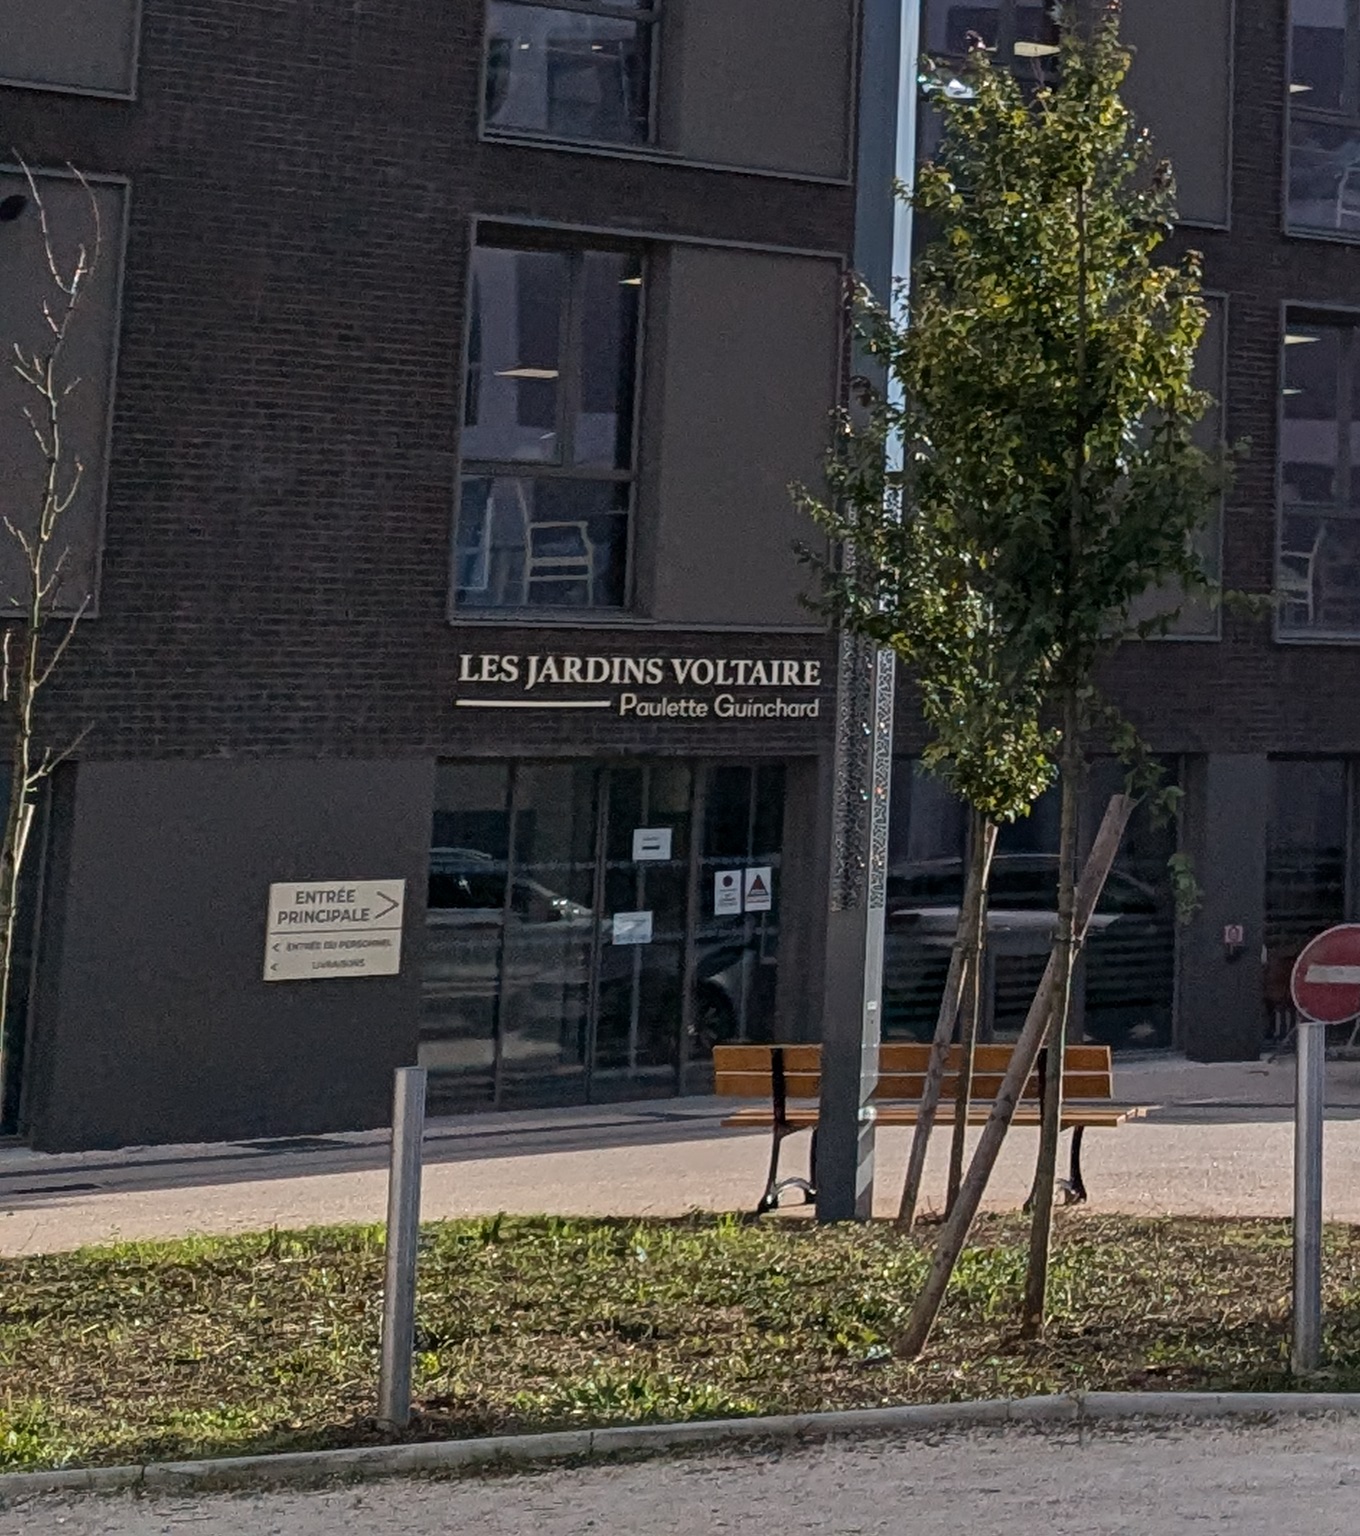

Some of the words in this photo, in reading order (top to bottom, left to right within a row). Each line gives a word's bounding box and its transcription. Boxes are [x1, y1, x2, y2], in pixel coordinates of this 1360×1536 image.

[457, 654, 519, 682] LES
[524, 655, 664, 690] JARDINS
[672, 660, 822, 687] VOLTAIRE
[619, 693, 709, 718] Paulette
[714, 694, 820, 718] Guinchard
[295, 888, 356, 905] ENTRÉE
[278, 908, 370, 924] PRINCIPALE
